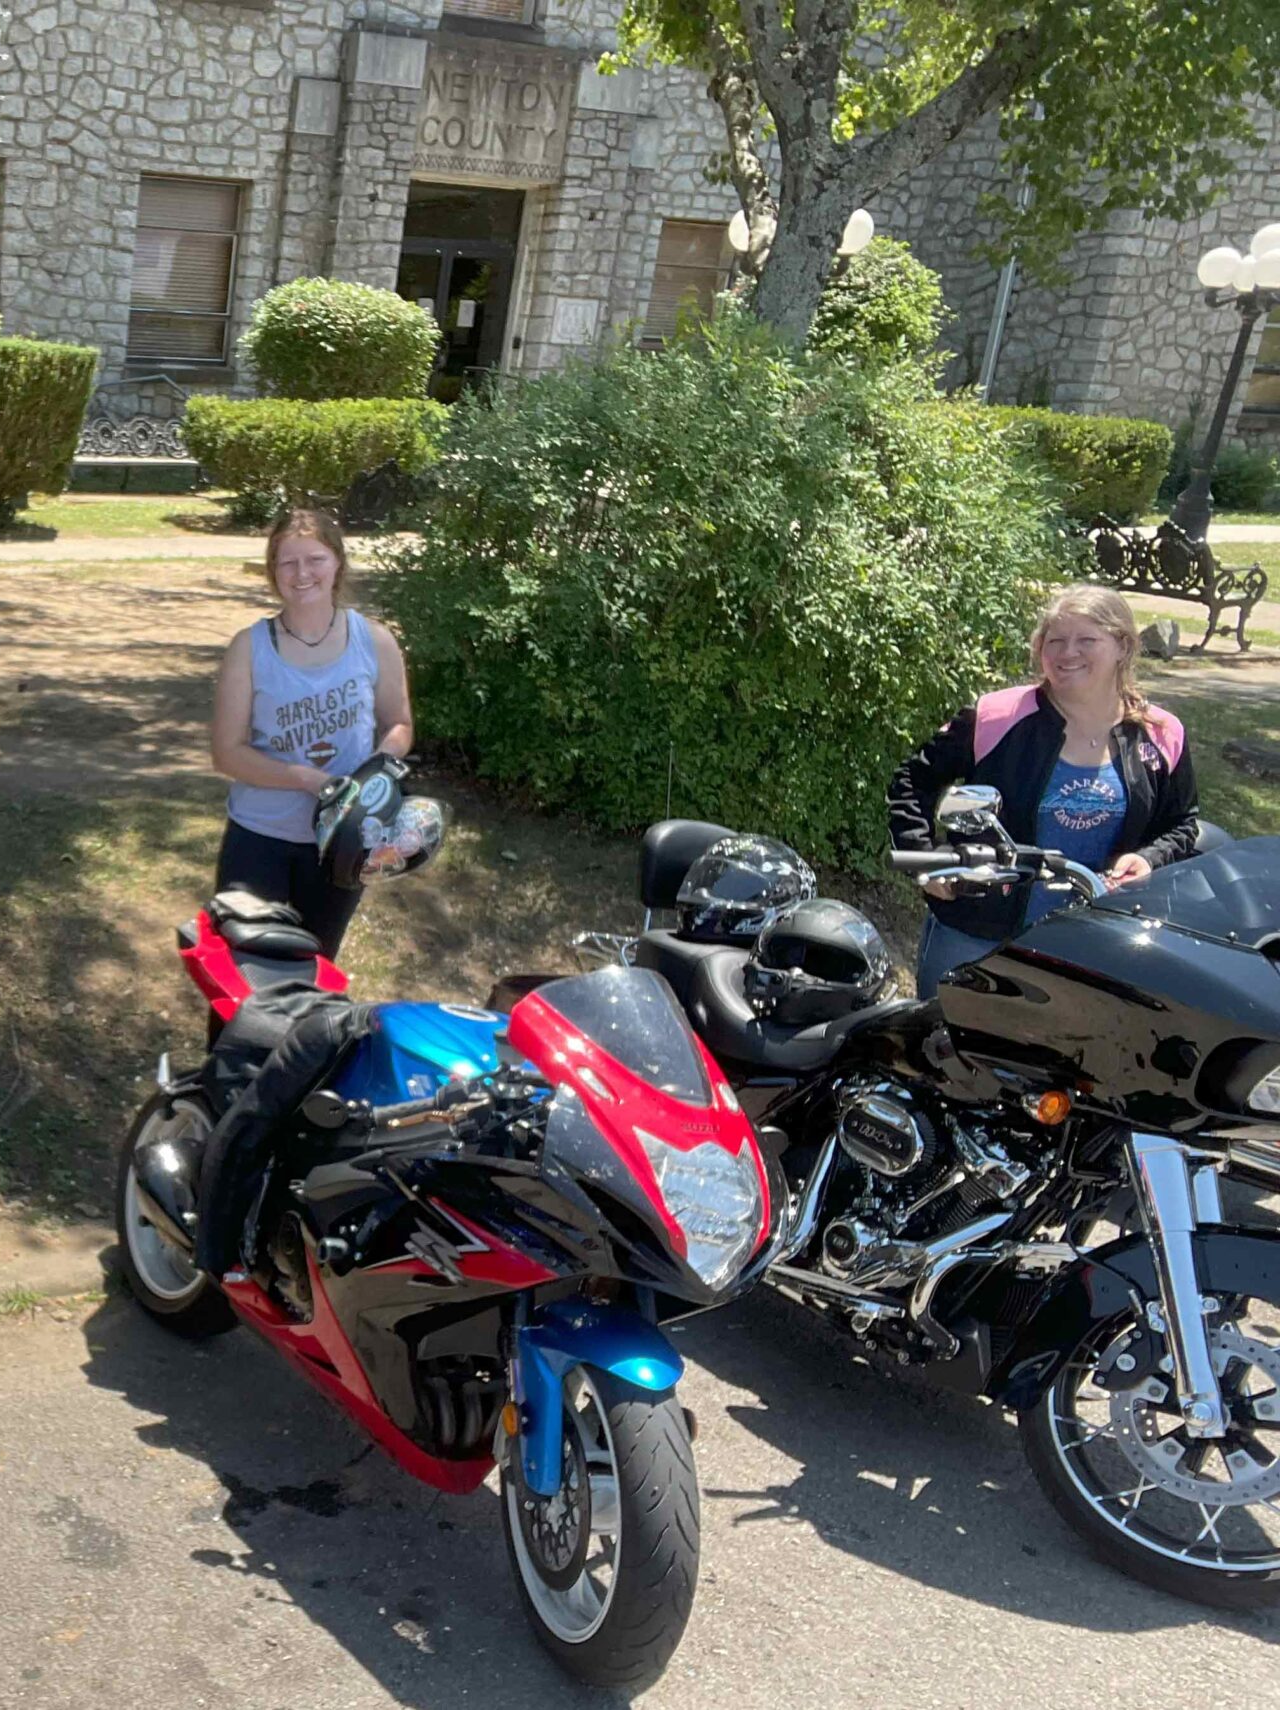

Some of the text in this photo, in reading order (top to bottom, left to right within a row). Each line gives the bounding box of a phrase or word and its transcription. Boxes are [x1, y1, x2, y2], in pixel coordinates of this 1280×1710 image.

[425, 69, 564, 112] NEWTON
[421, 116, 558, 158] COUNTY
[271, 701, 365, 752] DAVIDSON
[1060, 778, 1116, 803] HARLEY
[1054, 808, 1110, 830] DAVIDSON
